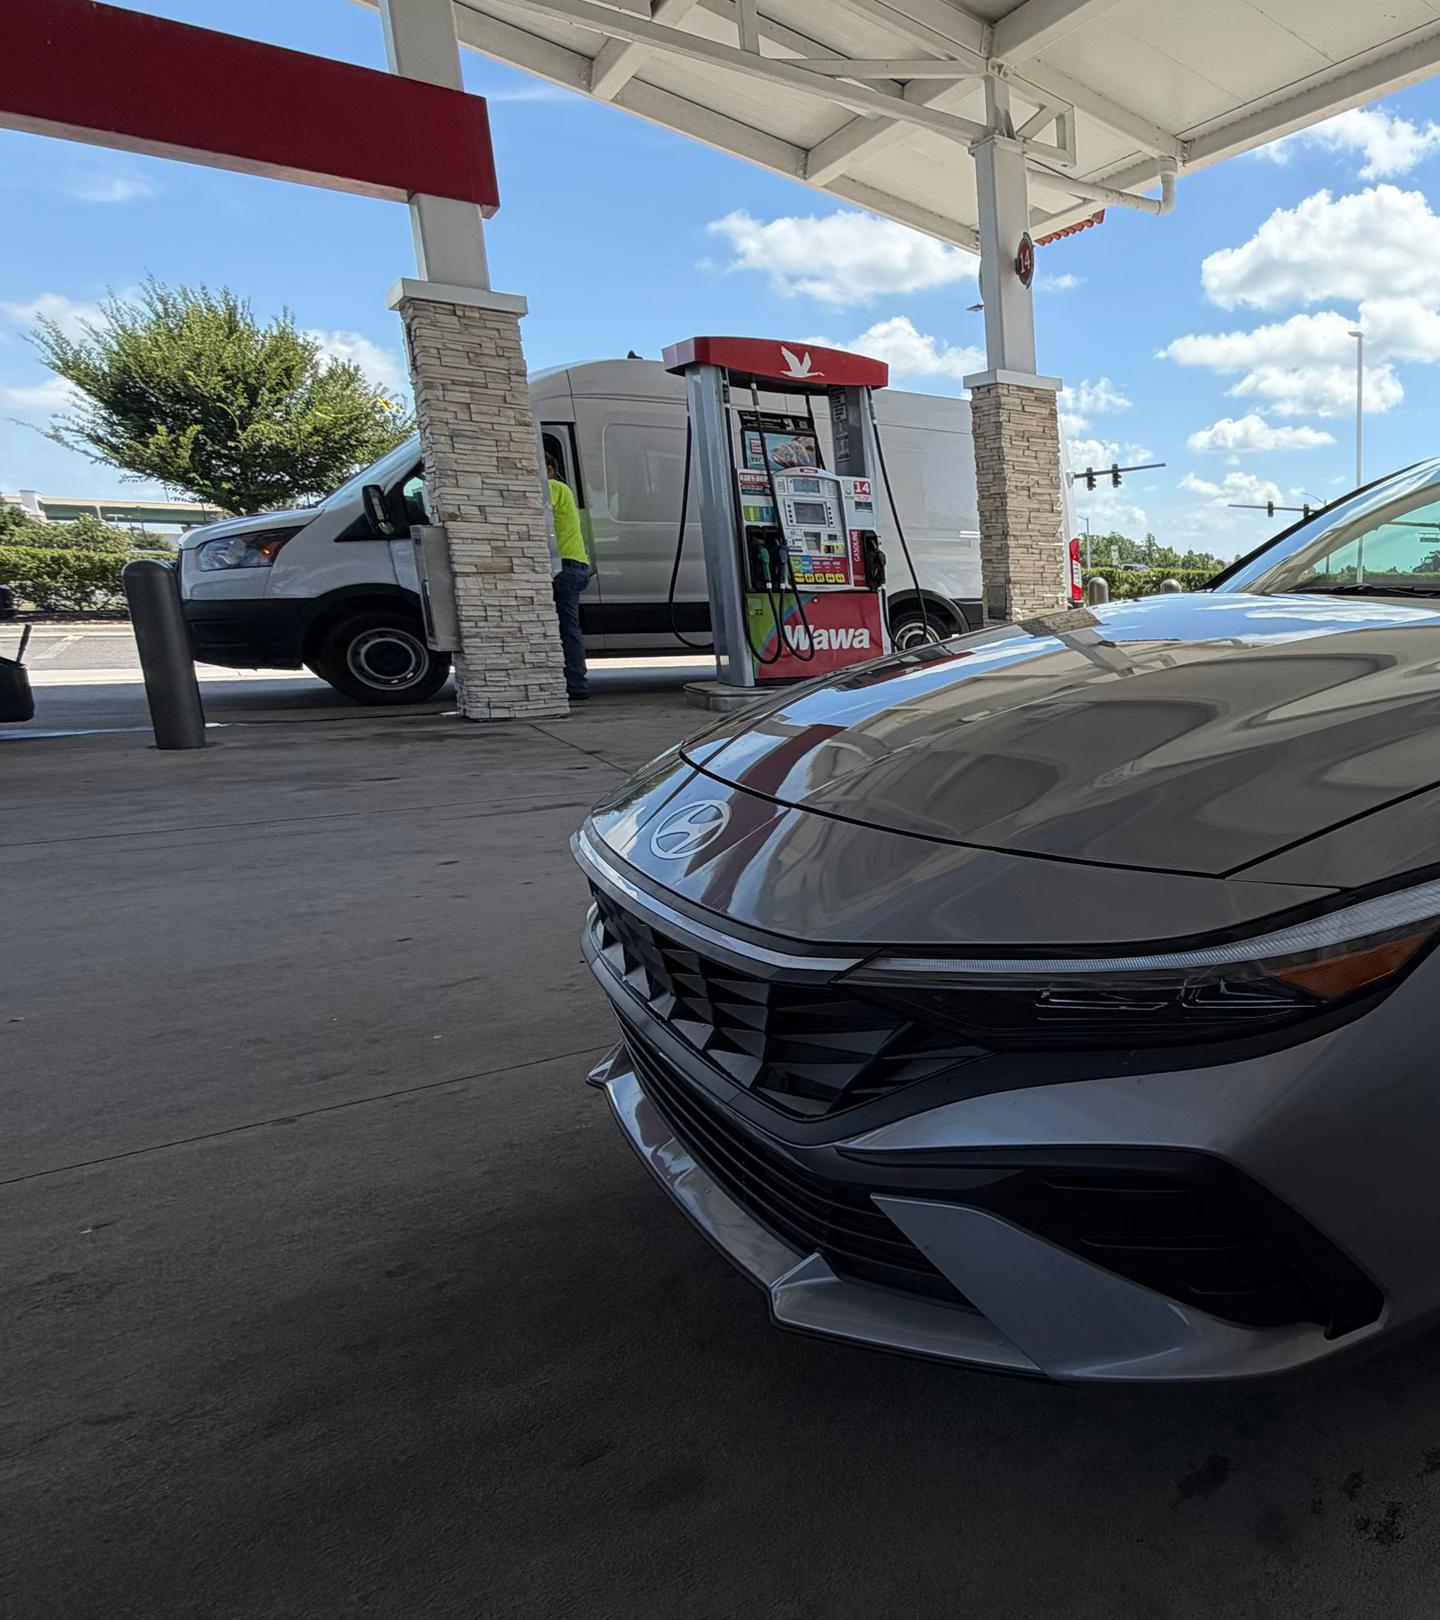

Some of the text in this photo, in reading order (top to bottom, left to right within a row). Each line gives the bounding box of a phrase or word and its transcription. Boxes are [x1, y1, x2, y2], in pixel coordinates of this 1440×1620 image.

[1020, 248, 1031, 274] 14
[854, 482, 870, 494] 14
[851, 531, 861, 561] GASOLINE
[783, 624, 870, 651] Wawa
